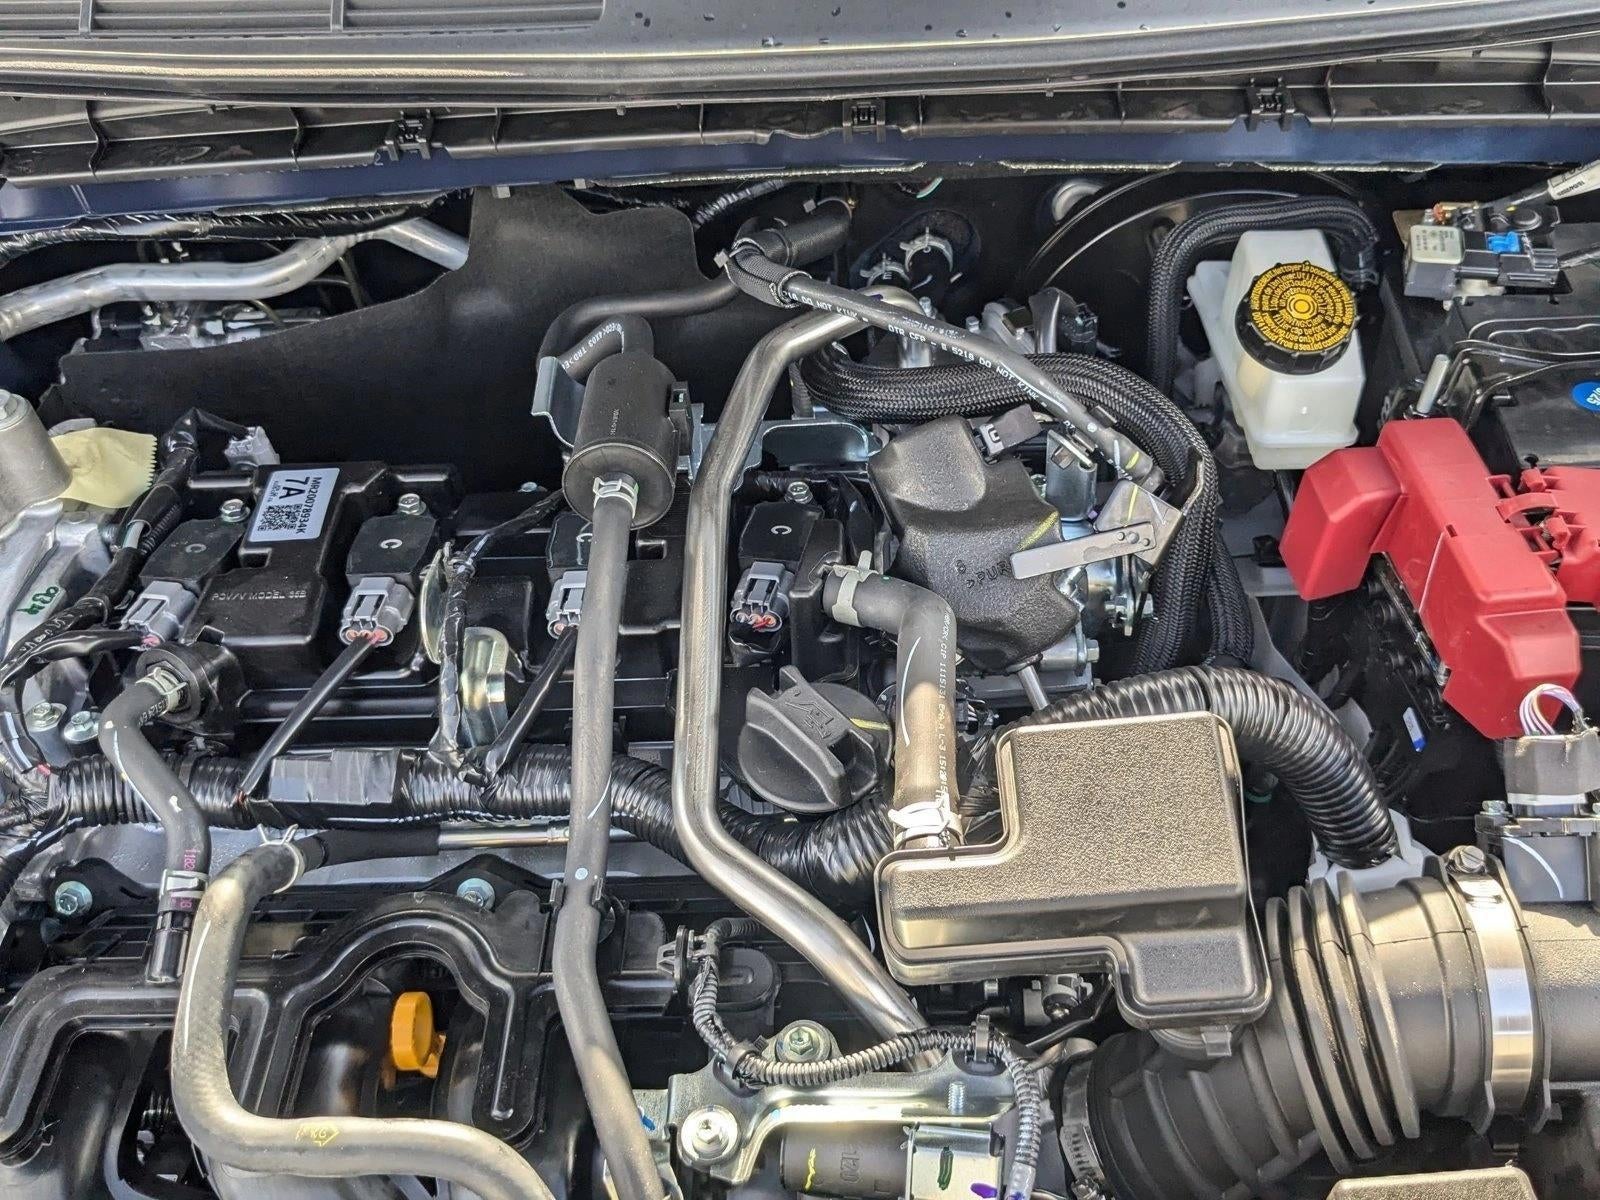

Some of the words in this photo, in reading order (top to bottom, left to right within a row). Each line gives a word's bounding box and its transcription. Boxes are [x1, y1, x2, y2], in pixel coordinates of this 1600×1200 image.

[816, 300, 833, 312] NOT
[979, 356, 992, 368] DO
[996, 366, 1016, 382] NOT
[1017, 382, 1039, 400] KINK
[278, 476, 310, 500] 7A
[248, 590, 286, 600] MODEL
